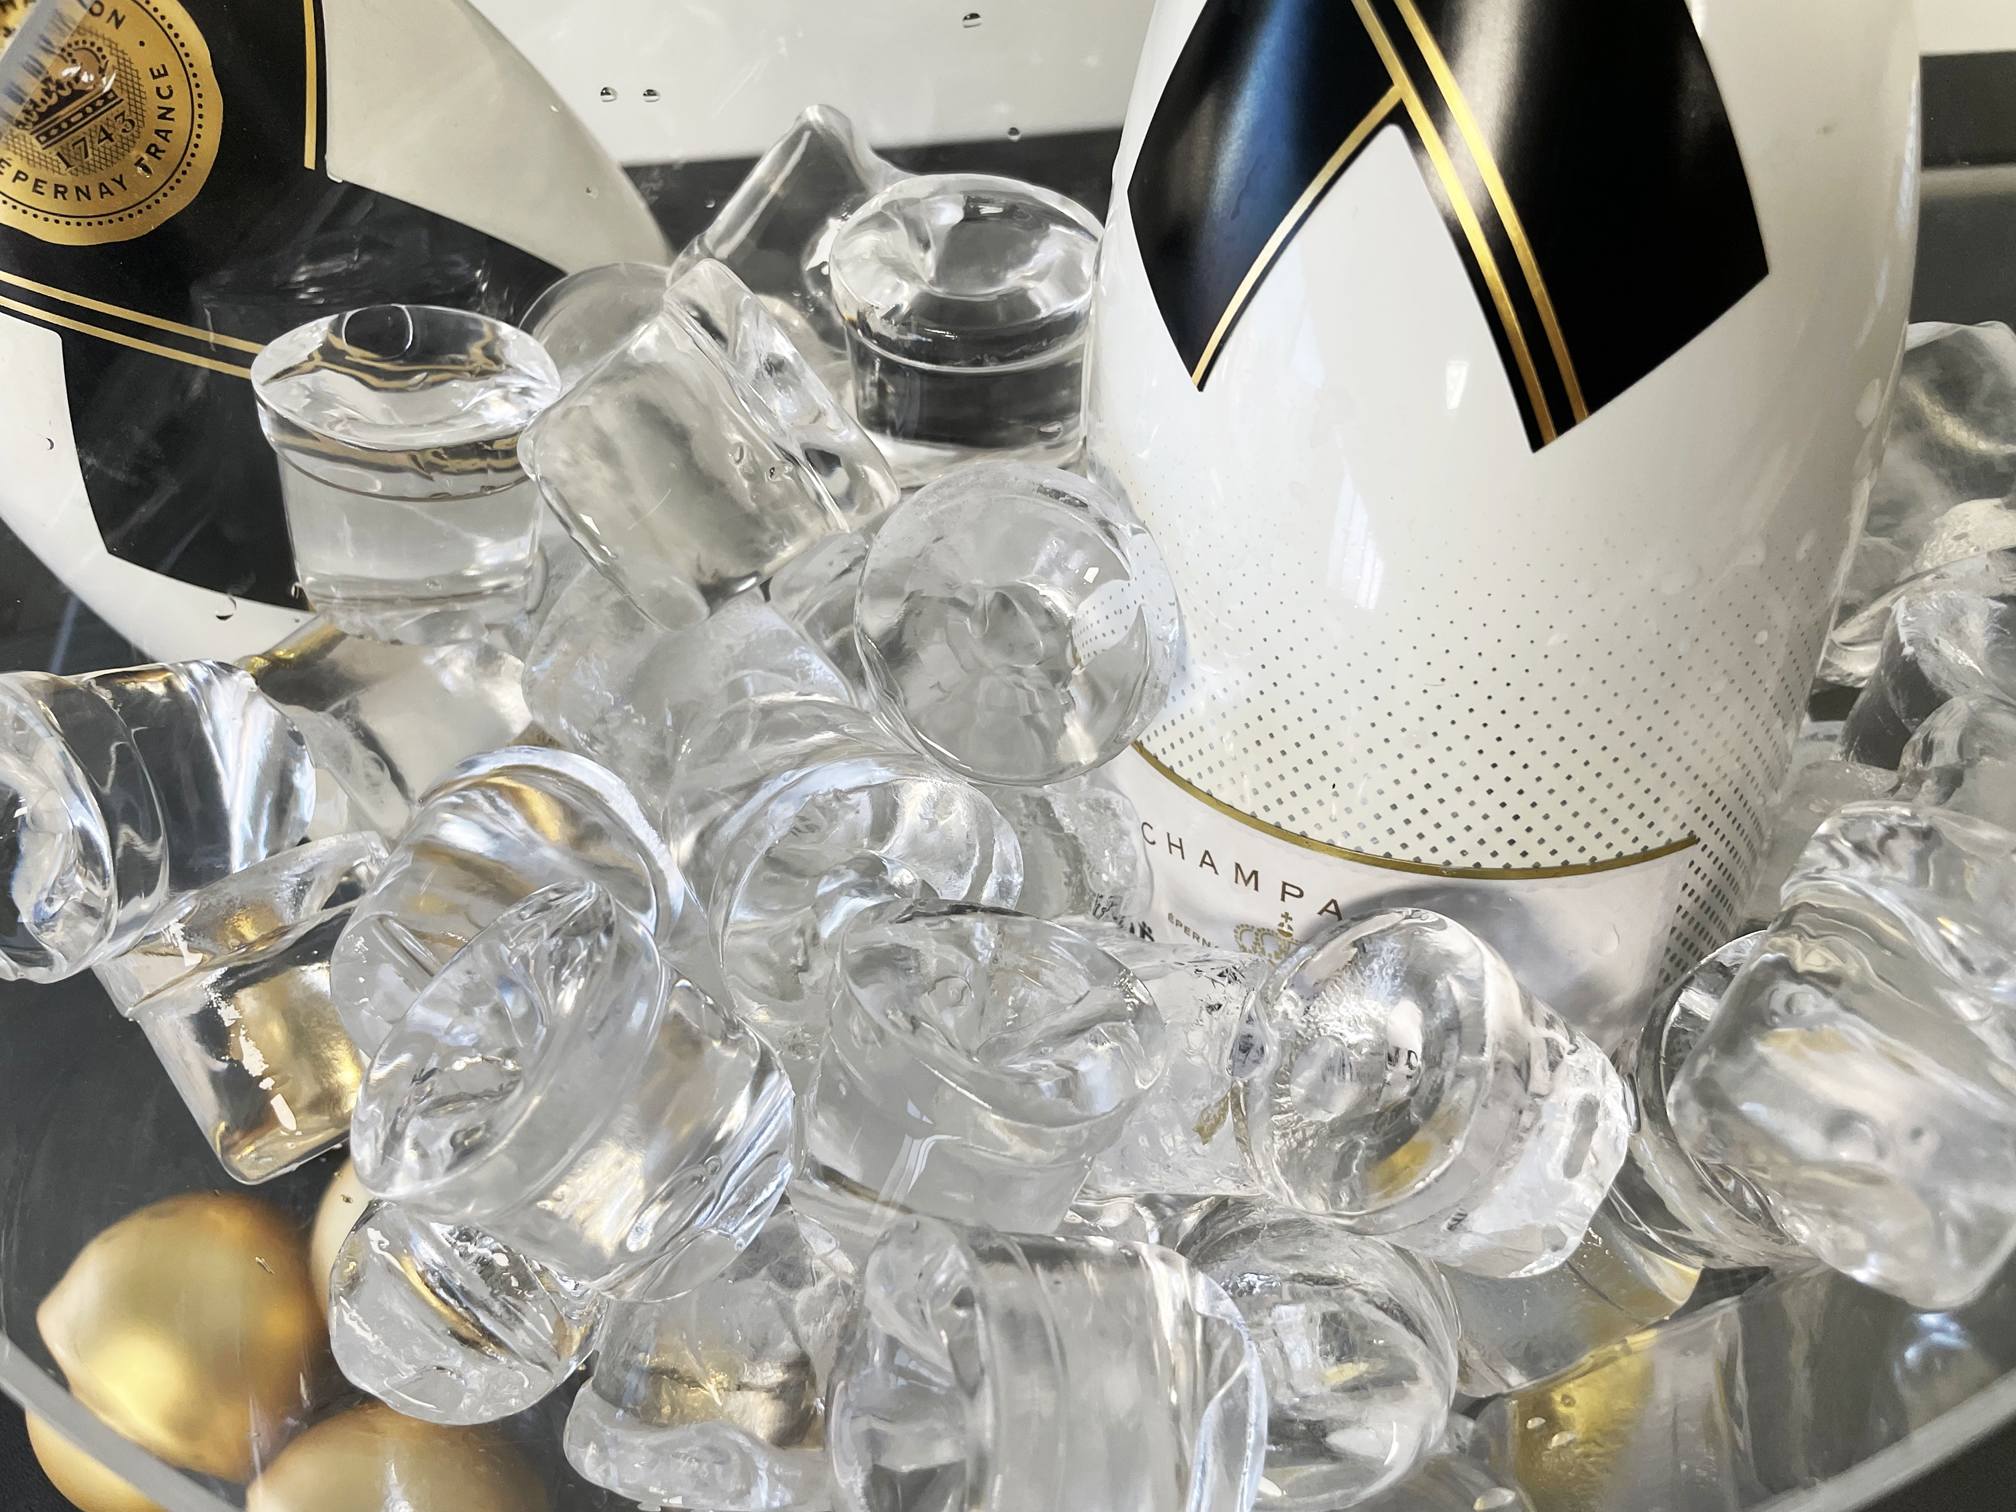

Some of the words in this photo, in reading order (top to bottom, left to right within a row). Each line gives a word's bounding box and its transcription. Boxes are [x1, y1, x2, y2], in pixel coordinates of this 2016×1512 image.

[56, 110, 136, 170] 1743
[1141, 821, 1343, 921] CHAMPA
[1167, 912, 1219, 949] ÉPERN
